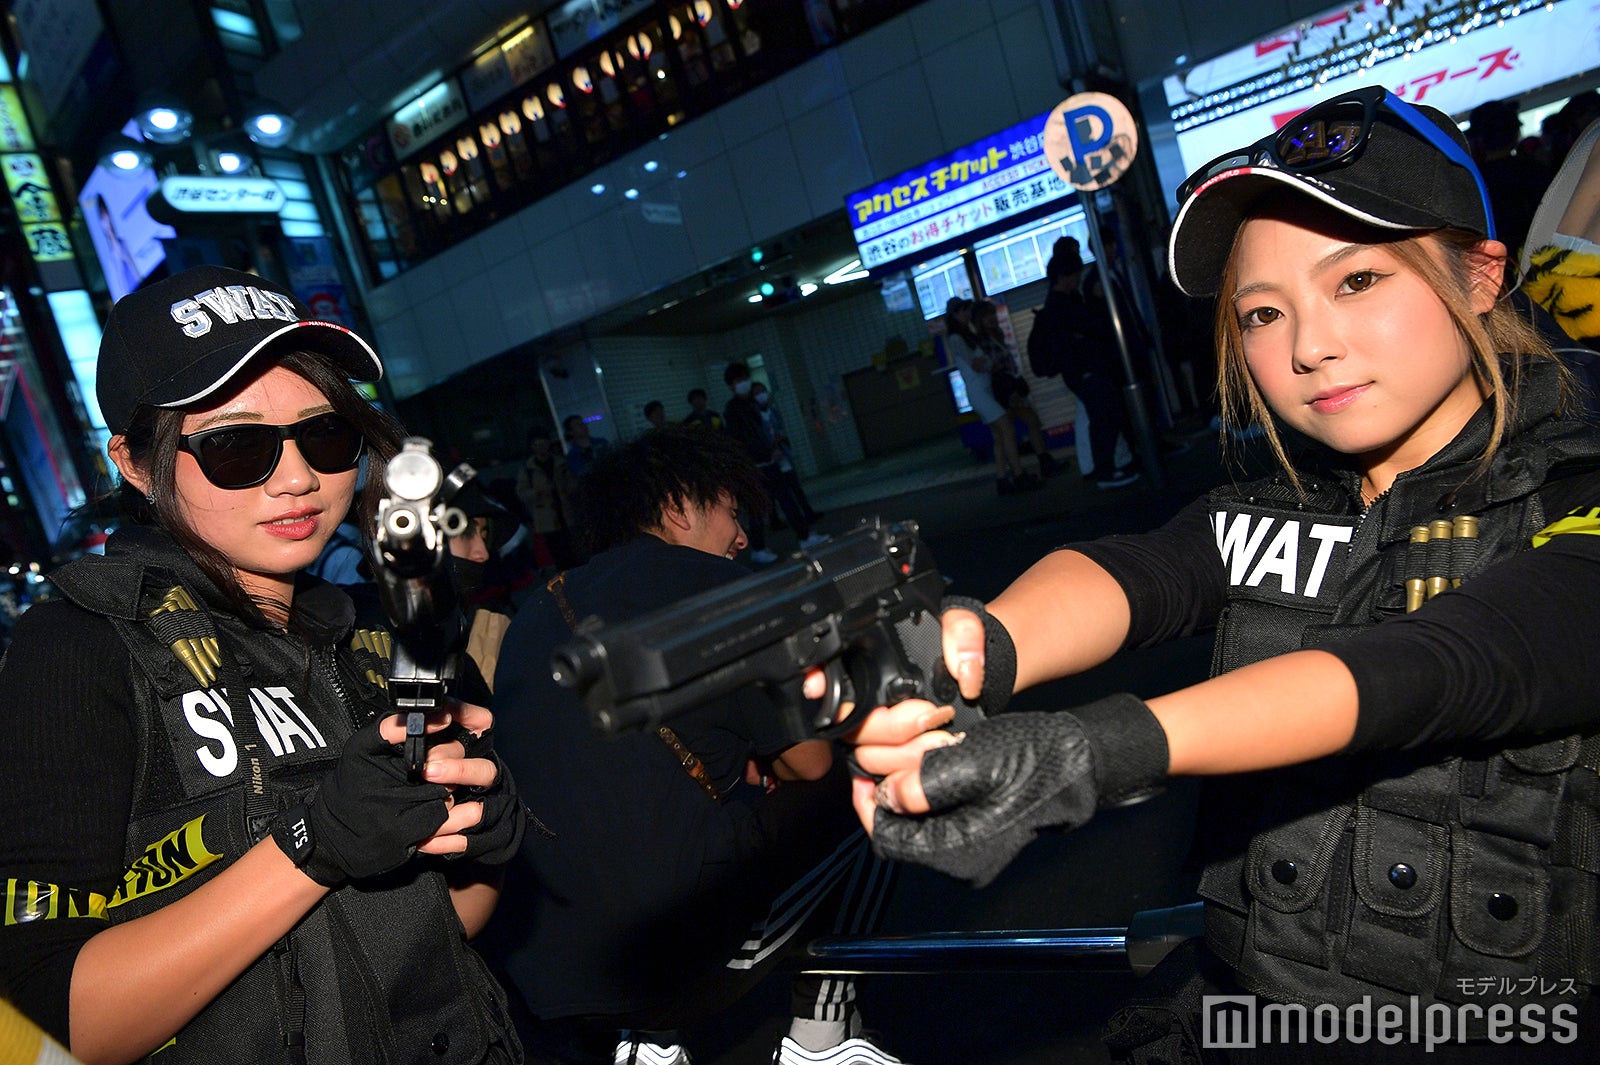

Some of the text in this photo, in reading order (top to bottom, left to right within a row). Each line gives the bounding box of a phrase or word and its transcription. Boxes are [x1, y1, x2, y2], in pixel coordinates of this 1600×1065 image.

[854, 147, 1008, 223] アクセスチケット
[170, 285, 300, 338] SWAT
[1208, 511, 1354, 598] WAT
[251, 757, 264, 795] Nikon
[291, 818, 309, 849] 5.11
